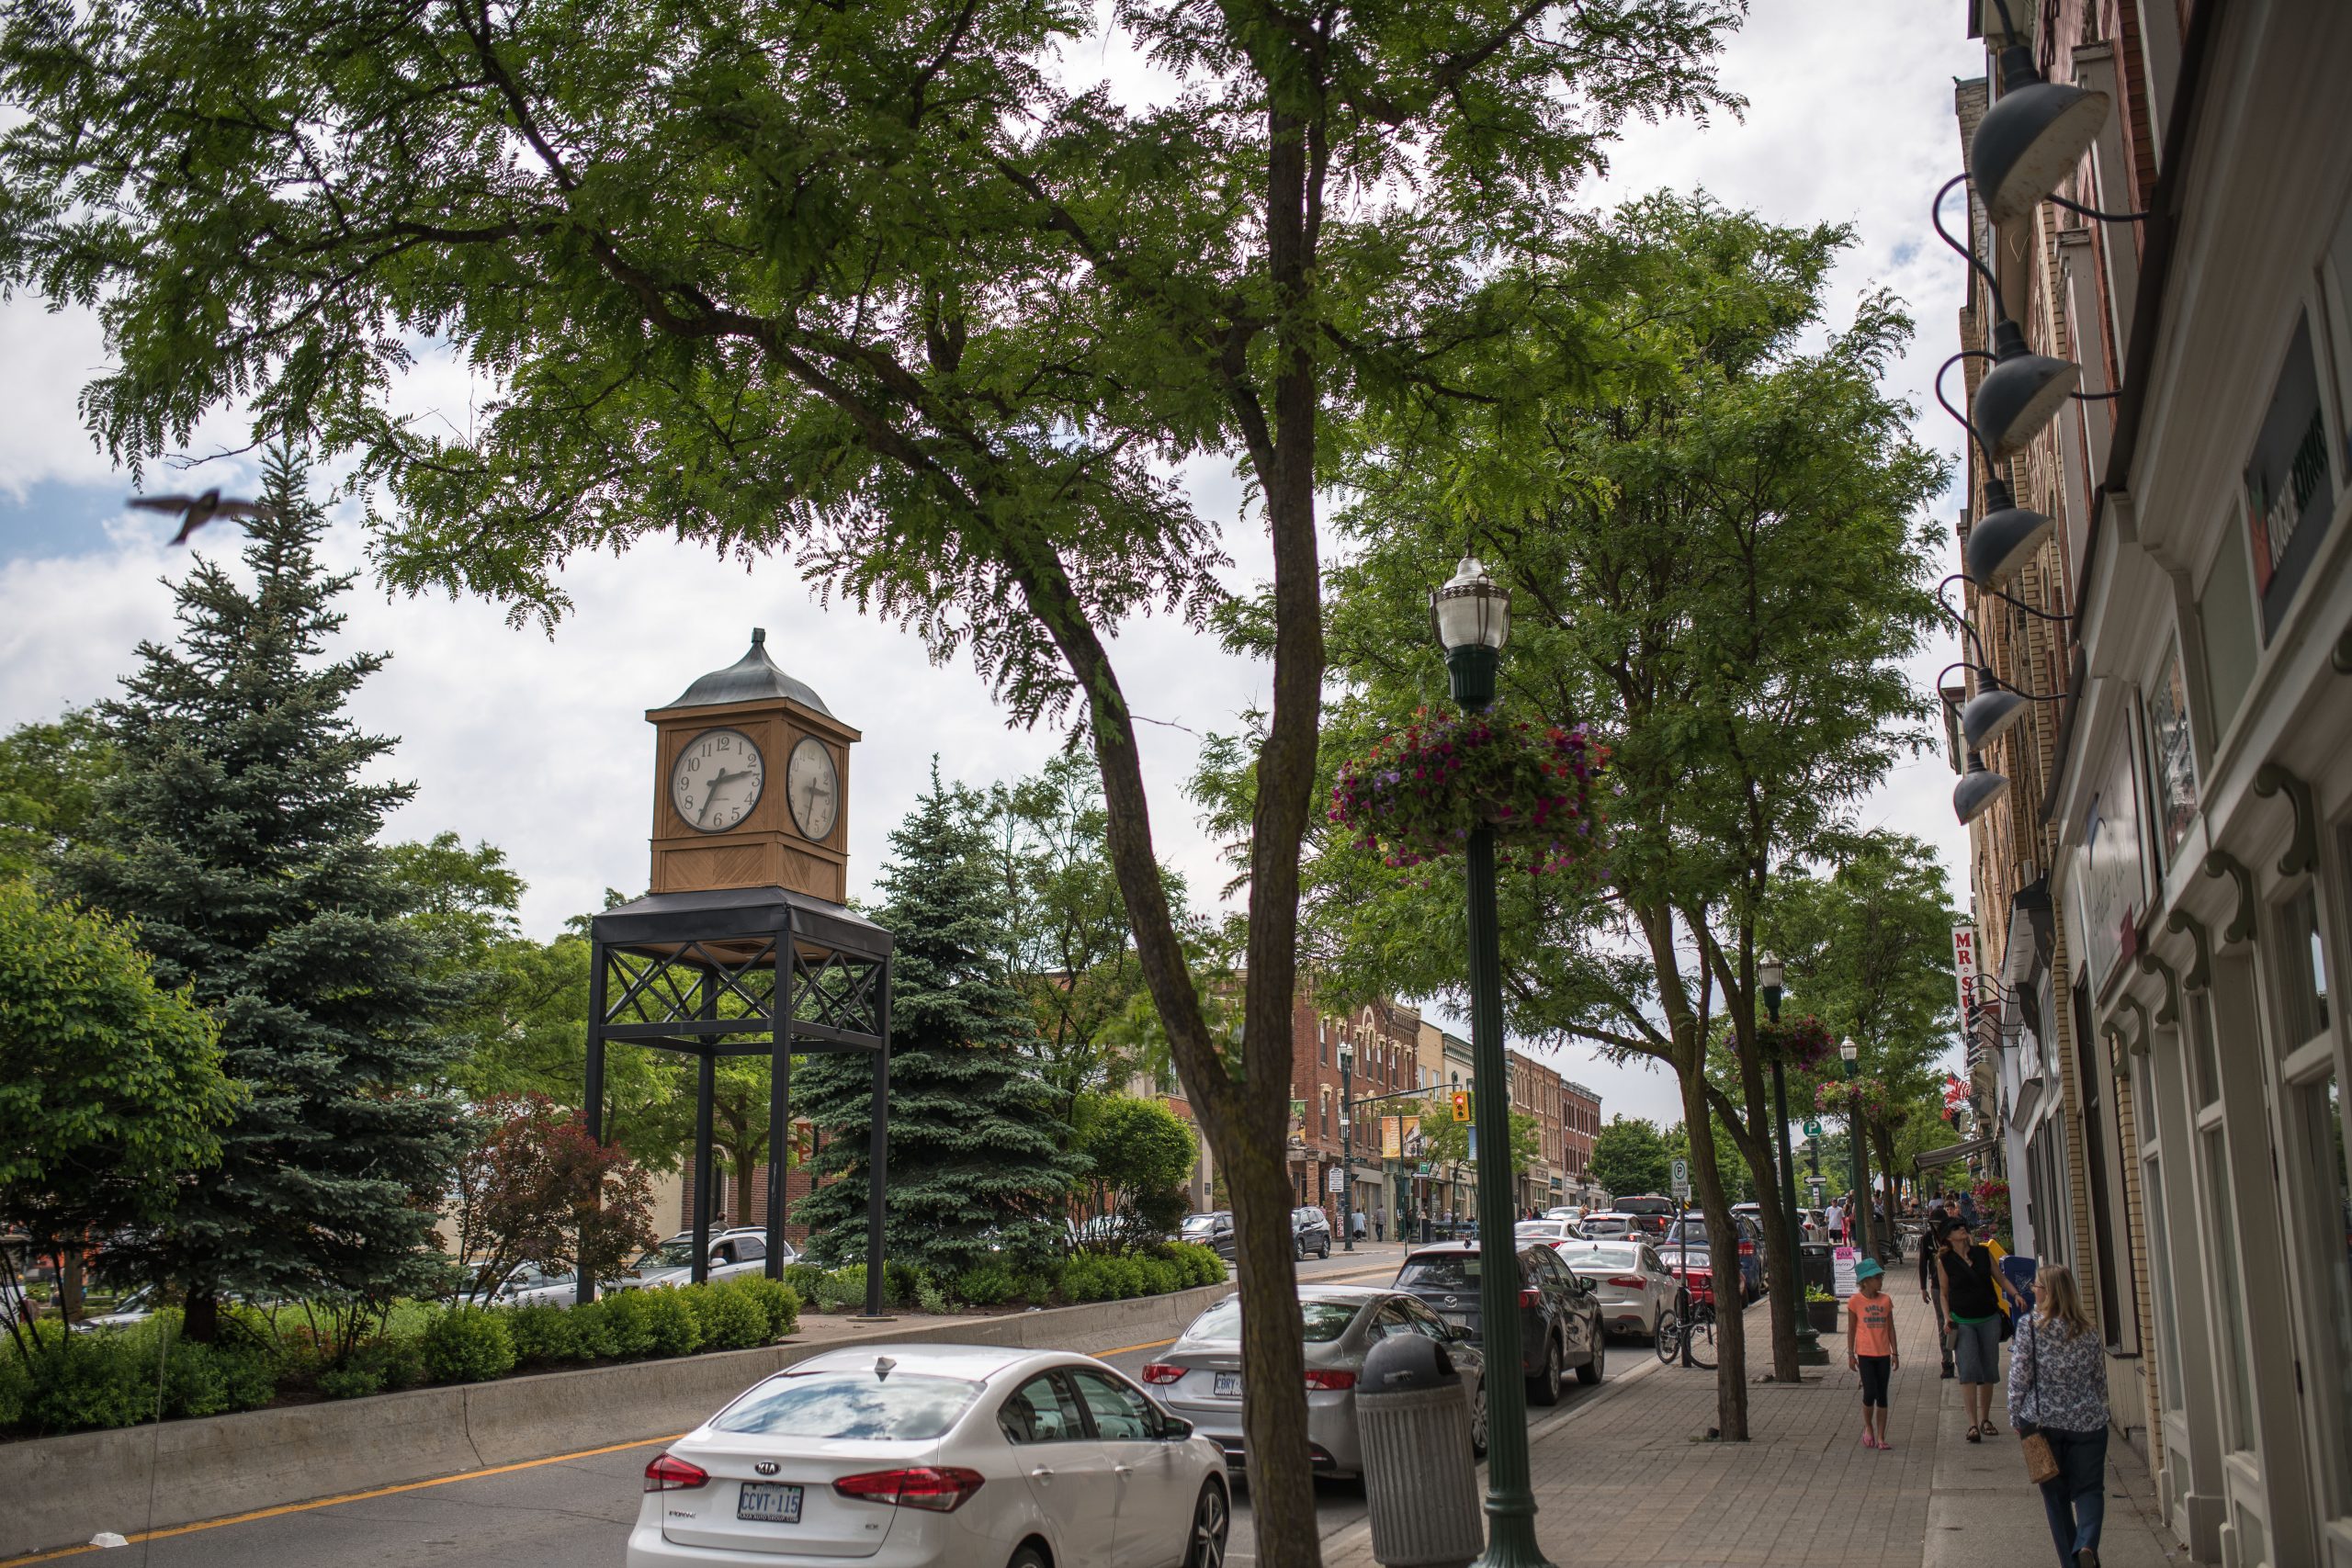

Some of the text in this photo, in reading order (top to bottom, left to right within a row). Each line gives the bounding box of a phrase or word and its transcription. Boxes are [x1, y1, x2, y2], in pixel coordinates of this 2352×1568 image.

[702, 742, 712, 757] 11
[717, 737, 729, 751] 12
[739, 741, 742, 755] 1
[687, 757, 700, 772] 10
[747, 753, 757, 768] 2
[680, 776, 689, 791] 9
[752, 773, 761, 787] 3
[684, 795, 694, 809] 8
[744, 791, 753, 806] 4
[713, 812, 722, 827] 6
[731, 807, 741, 821] 5
[758, 1464, 775, 1472] KIA
[741, 1492, 799, 1514] CCVT 115
